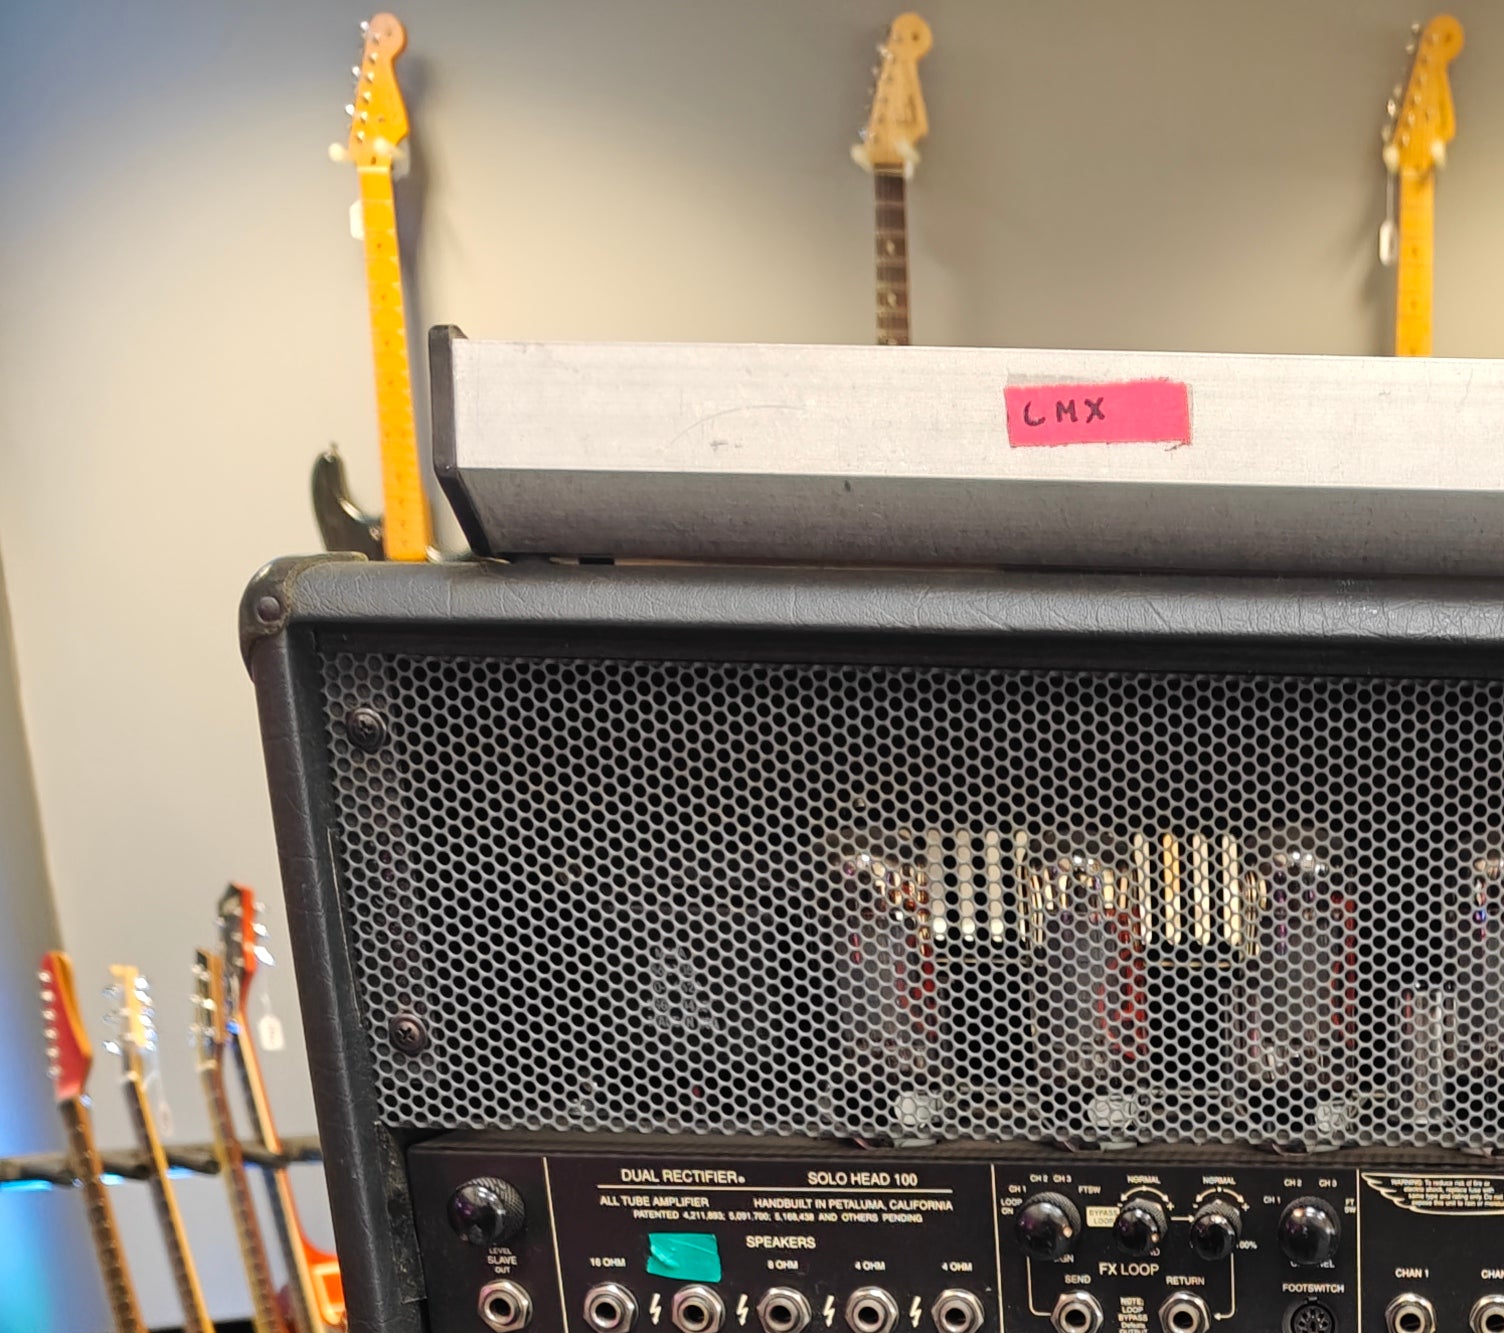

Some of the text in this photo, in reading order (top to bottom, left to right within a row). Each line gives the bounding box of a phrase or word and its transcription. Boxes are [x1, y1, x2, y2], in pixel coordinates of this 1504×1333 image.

[1023, 396, 1106, 426] CMX
[620, 1168, 660, 1183] DUAL
[807, 1172, 919, 1187] SOLO HEAD 100
[1127, 1175, 1161, 1184] NORMAL
[1203, 1176, 1237, 1185] NORMAL
[1008, 1185, 1020, 1194] CH
[599, 1195, 710, 1208] ALL TUBE AMPLIFIER
[753, 1198, 953, 1211] HANDBUILT IN PETALUMA, CALIFORNIA
[1000, 1198, 1023, 1207] LOOP
[1264, 1196, 1276, 1204] CH
[633, 1209, 680, 1220] PATENTED
[818, 1213, 838, 1222] AND
[841, 1213, 879, 1222] OTHERS
[882, 1213, 923, 1223] PENDING
[1001, 1206, 1014, 1215] ON
[745, 1235, 817, 1249] SPEAKERS
[487, 1255, 518, 1266] SLAVE
[602, 1257, 627, 1268] OHM
[775, 1260, 799, 1270] OHM
[854, 1261, 886, 1271] 4 OHM
[494, 1266, 511, 1275] OUT
[949, 1261, 973, 1272] OHM
[1099, 1262, 1160, 1277] FX LOOP
[1064, 1274, 1092, 1284] SEND
[1395, 1268, 1423, 1279] CHAN
[1165, 1275, 1206, 1286] RETURN
[1282, 1283, 1345, 1294] FOOTSWITCH
